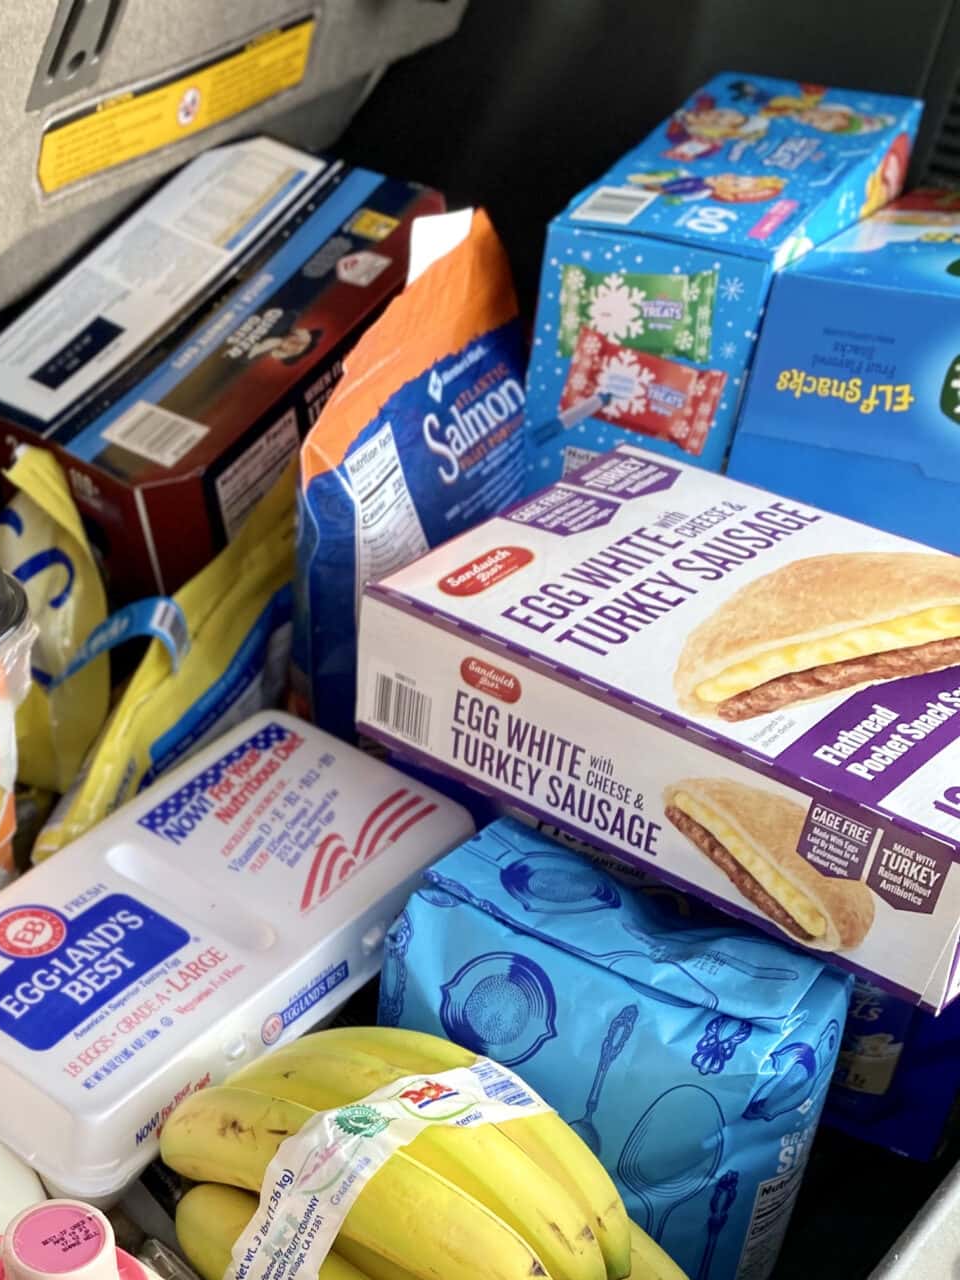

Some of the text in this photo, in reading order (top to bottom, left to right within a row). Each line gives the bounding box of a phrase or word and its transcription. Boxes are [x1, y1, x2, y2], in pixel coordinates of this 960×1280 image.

[423, 378, 526, 484] Salmon
[674, 499, 748, 538] CHEESE &
[445, 548, 511, 588] Sandwich
[501, 581, 594, 634] EGG
[562, 526, 686, 592] WHITE
[653, 511, 689, 531] with
[554, 501, 822, 657] TURKEY SAUSAGE
[468, 660, 514, 689] Sandwich
[453, 690, 614, 780] EGG WHITE with
[813, 704, 900, 767] Flatbread
[845, 699, 957, 781] Pocket Snack
[163, 748, 262, 845] NOW! For Your
[214, 758, 281, 825] Nutritious
[272, 731, 304, 762] Diet
[451, 727, 662, 856] TURKEY SAUSAGE
[586, 771, 644, 809] CHEESE &
[812, 807, 872, 843] CAGE FREE
[813, 827, 829, 839] Made
[227, 835, 266, 873] Vitamins
[807, 851, 829, 869] Without
[882, 849, 941, 887] TURKEY
[893, 843, 936, 867] MADE WITH
[64, 882, 108, 914] FRESH
[878, 867, 931, 897] Raised Without
[880, 880, 923, 905] Antibiotics
[60, 948, 136, 1006] BEST
[326, 965, 348, 991] BEST
[62, 1058, 78, 1079] 18
[77, 1034, 114, 1068] EGGS
[116, 1002, 156, 1036] GRADE
[166, 946, 230, 993] LARGE
[135, 1112, 160, 1146] NOW!
[246, 1245, 258, 1262] wt.
[256, 1236, 263, 1246] 3
[262, 1220, 272, 1237] lbs
[279, 1168, 296, 1190] kg)
[303, 1238, 312, 1252] CA
[309, 1214, 324, 1240] 91361
[274, 1255, 289, 1280] FRESH
[285, 1233, 301, 1261] FRUIT
[298, 1195, 320, 1236] COMPANY
